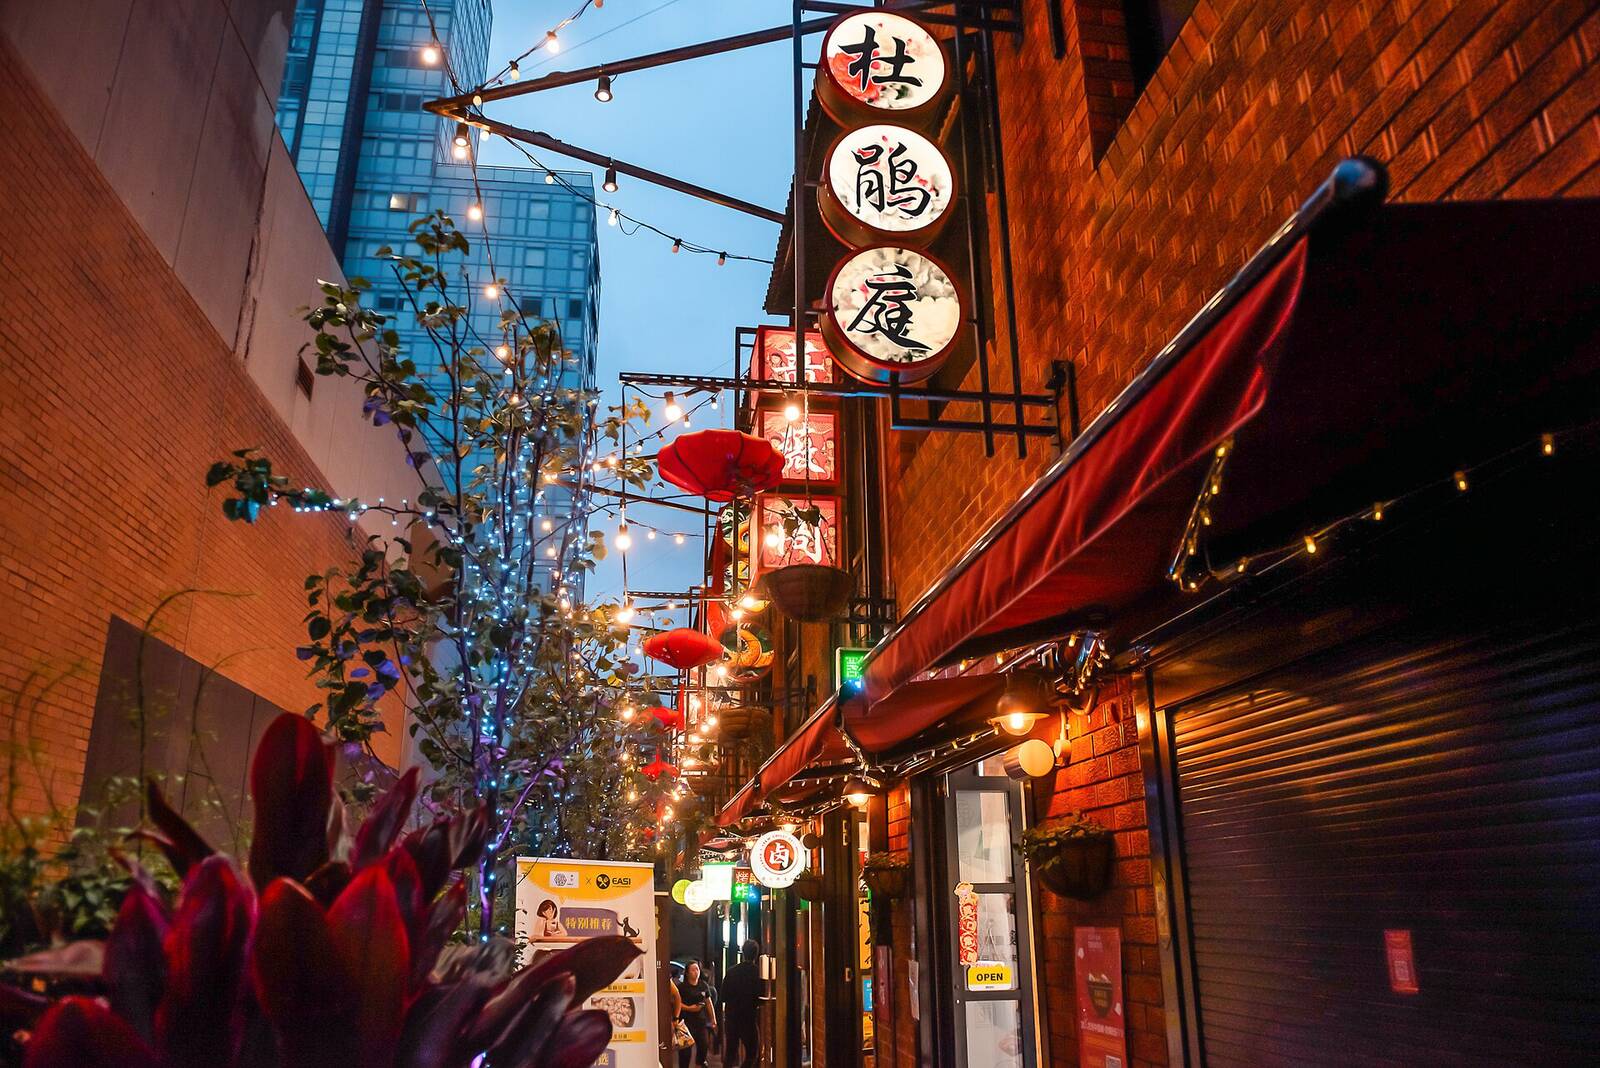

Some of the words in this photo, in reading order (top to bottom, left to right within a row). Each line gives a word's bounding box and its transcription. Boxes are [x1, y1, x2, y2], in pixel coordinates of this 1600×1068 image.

[838, 24, 932, 351] 杜鹃庭
[770, 842, 790, 868] 卤
[611, 877, 632, 886] EASI
[565, 916, 613, 931] 特别推荐
[976, 972, 1004, 982] OPEN
